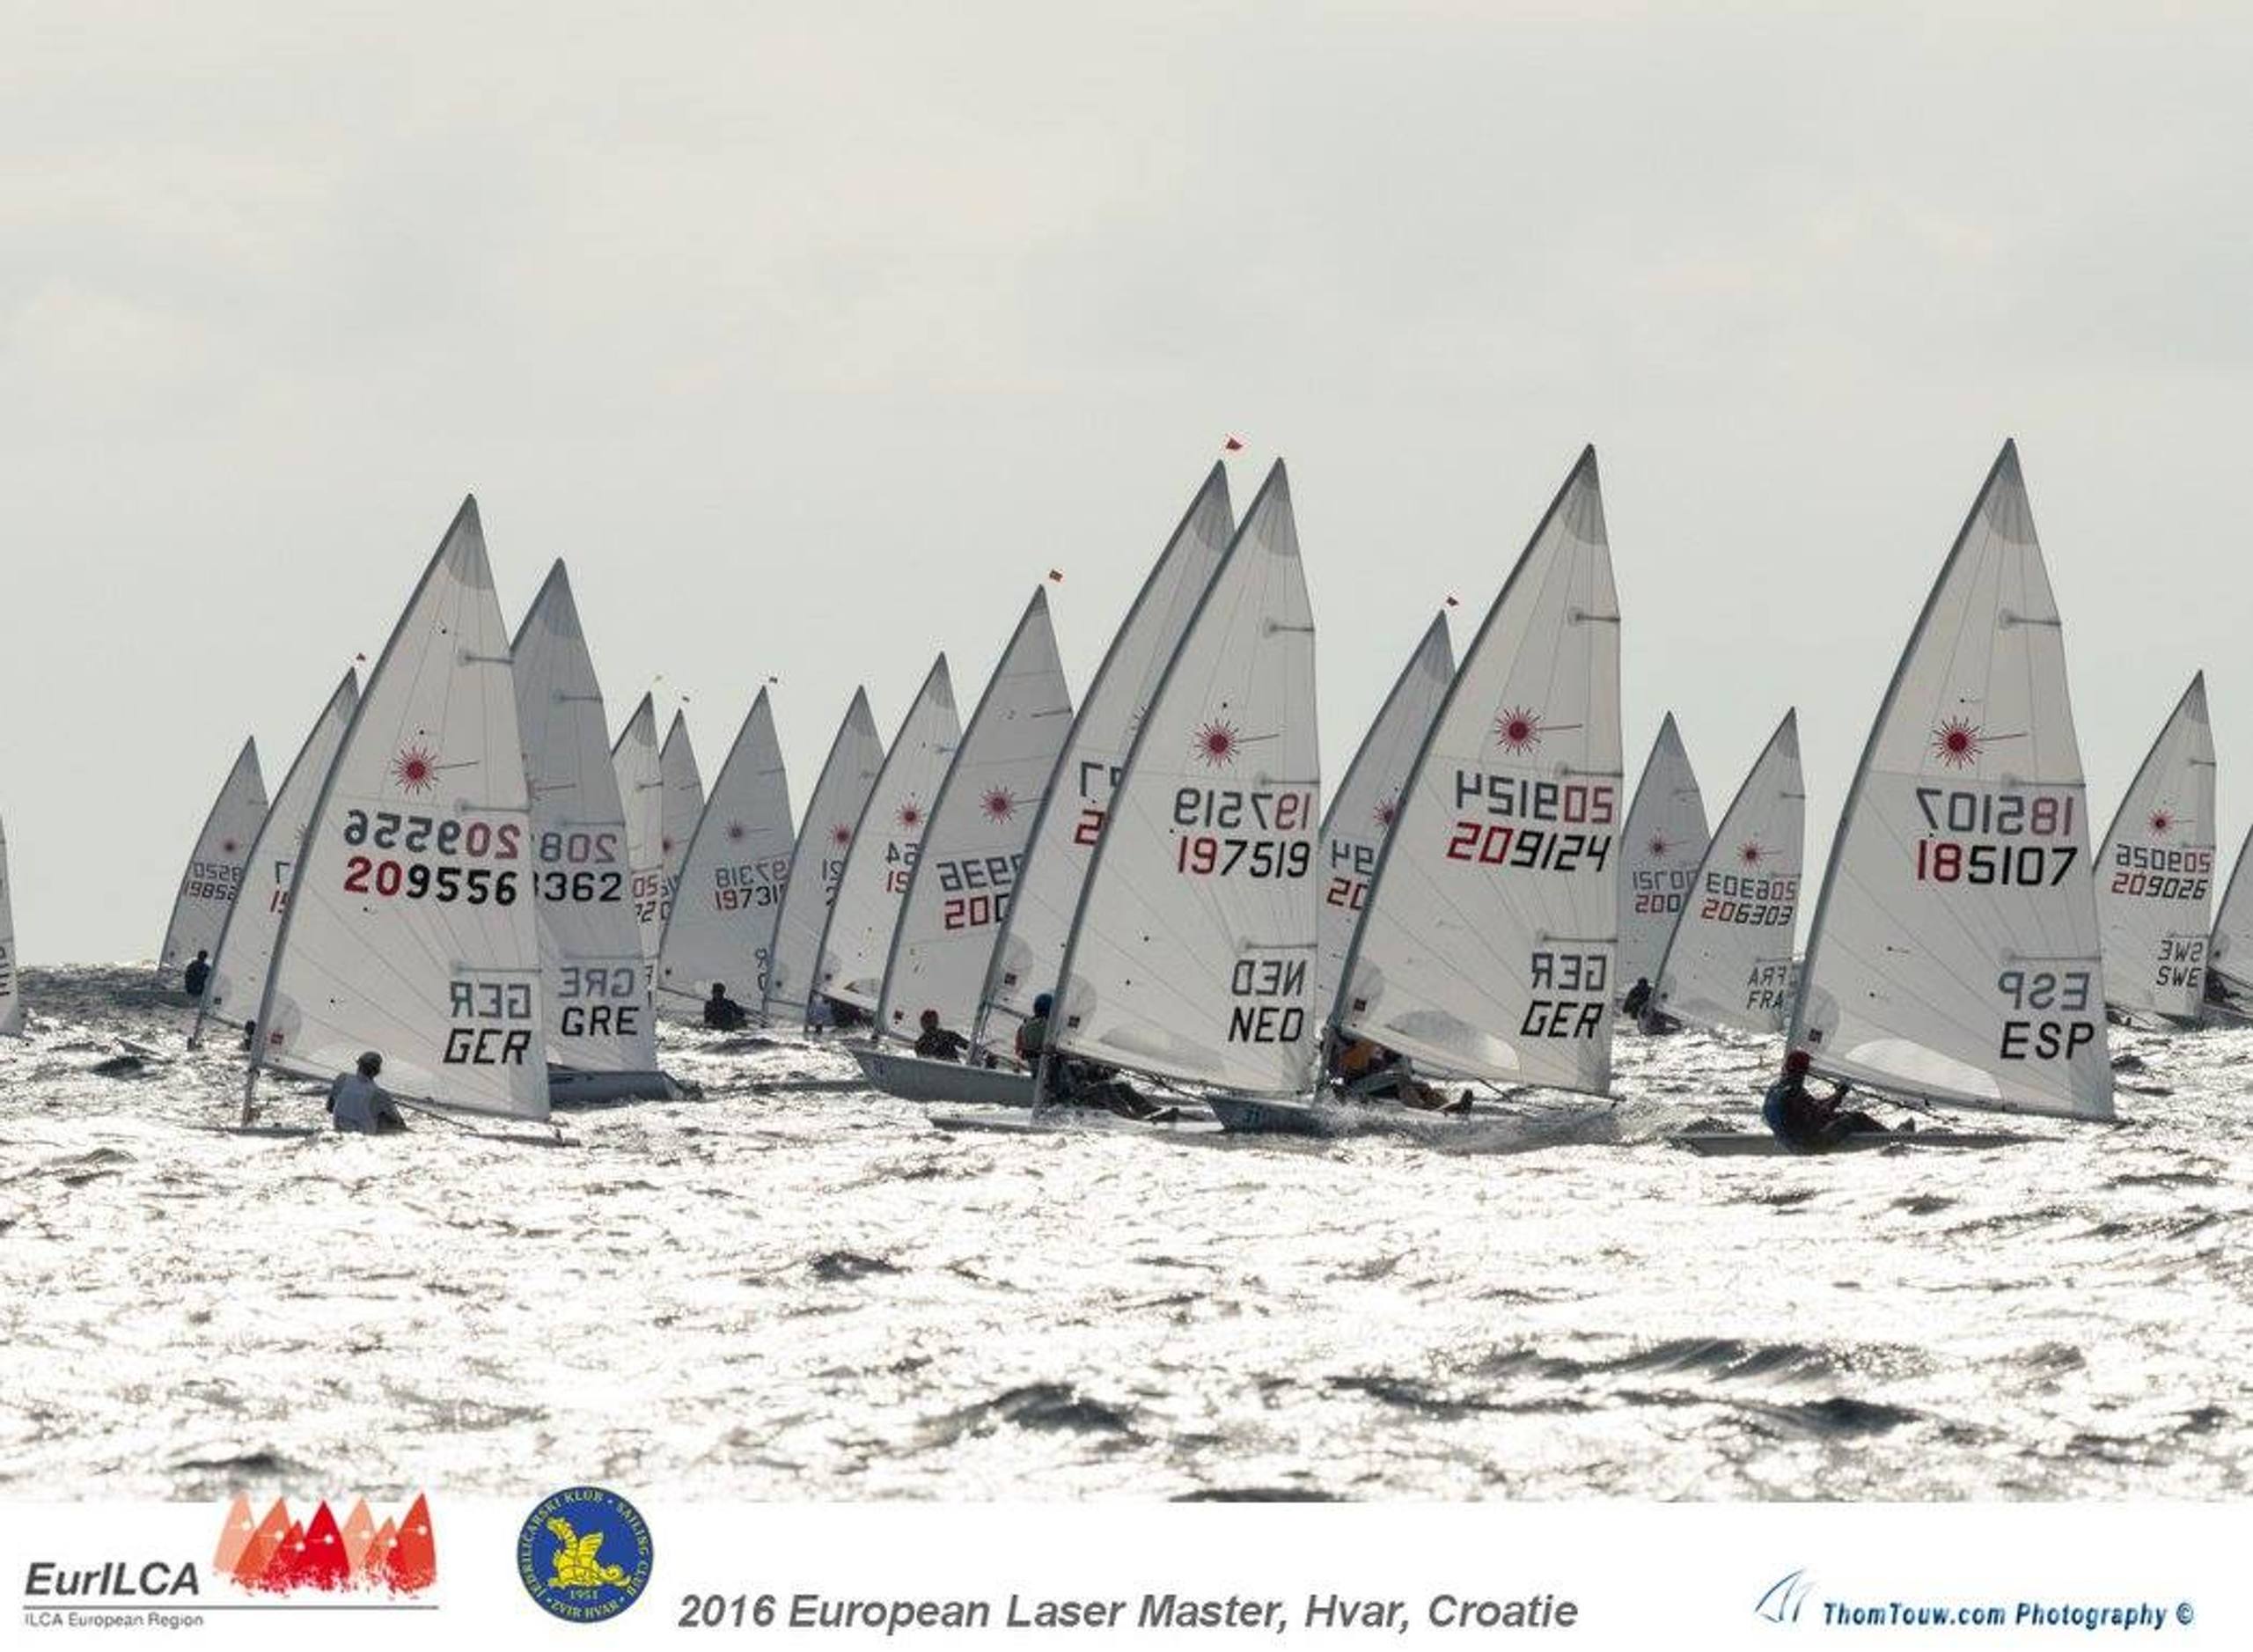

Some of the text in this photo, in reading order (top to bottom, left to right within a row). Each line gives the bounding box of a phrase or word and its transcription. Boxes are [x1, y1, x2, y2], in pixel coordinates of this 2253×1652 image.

[1178, 836, 1310, 878] 197519
[1447, 822, 1611, 871] 209124
[1917, 839, 2078, 885] 185107
[343, 856, 517, 906] 209556
[2111, 872, 2208, 900] 209026
[944, 893, 1011, 930] 200
[1635, 893, 1681, 913] 200
[1702, 899, 1793, 926] 206303
[2156, 966, 2201, 988] SWE
[1747, 990, 1785, 1010] FRA
[561, 1006, 640, 1036] GRE
[1228, 1007, 1303, 1042] NED
[1520, 1000, 1604, 1039] GER
[443, 1028, 532, 1065] GER
[2000, 1020, 2095, 1061] ESP
